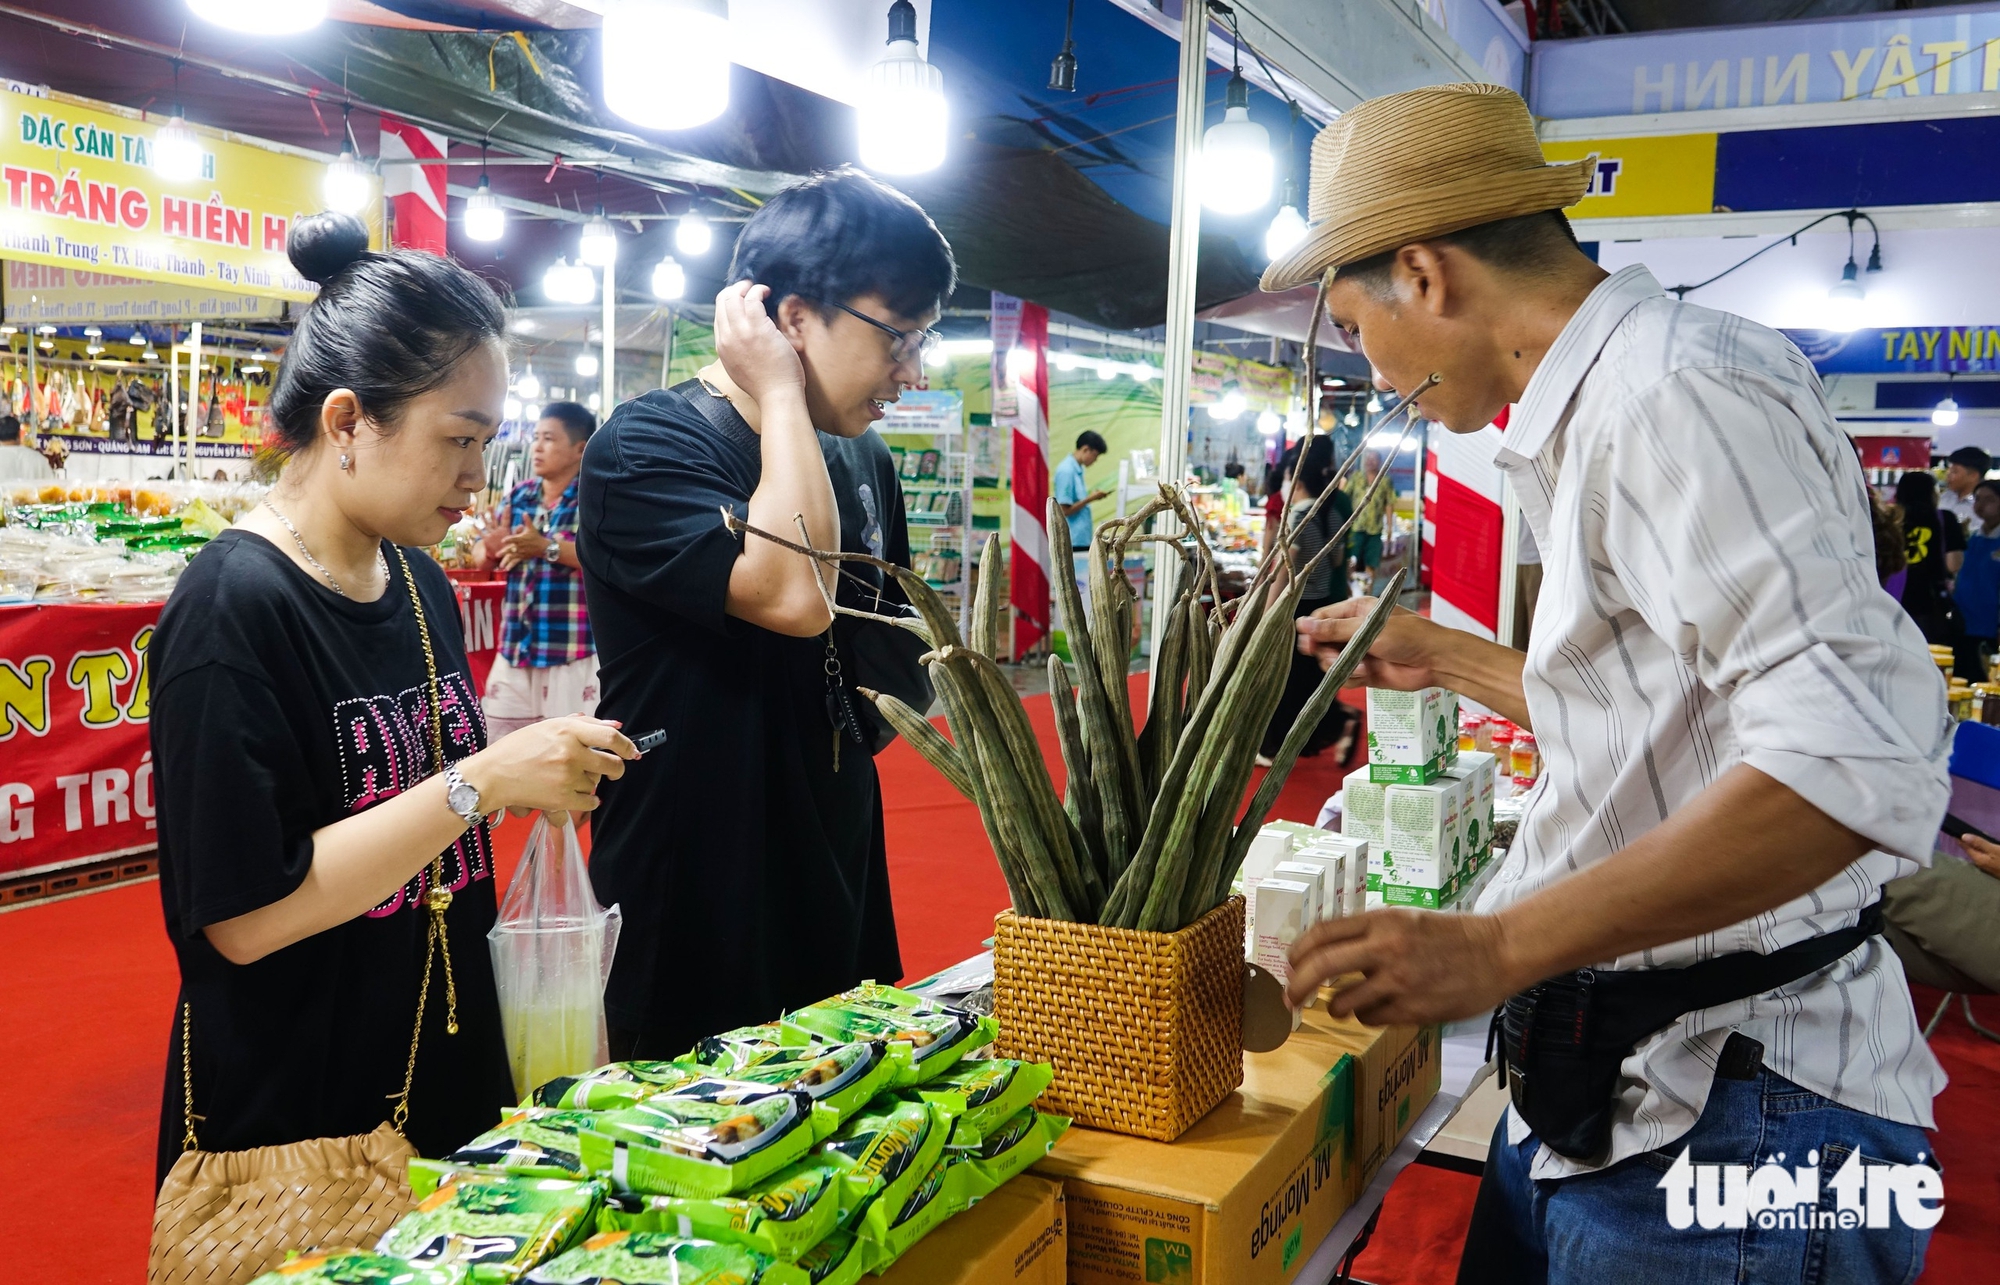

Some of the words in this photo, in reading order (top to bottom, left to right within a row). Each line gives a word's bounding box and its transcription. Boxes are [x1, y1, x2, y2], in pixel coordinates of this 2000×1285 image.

[21, 114, 66, 149] ĐẶC
[5, 167, 149, 229] TRÁNG
[163, 194, 250, 247] HIỀN
[55, 237, 99, 264] Trung
[1154, 1210, 1165, 1219] TY
[1166, 1213, 1191, 1224] CÔNG
[1251, 1166, 1310, 1260] Moringa
[1085, 1243, 1107, 1254] World
[1108, 1247, 1140, 1260] Moringa
